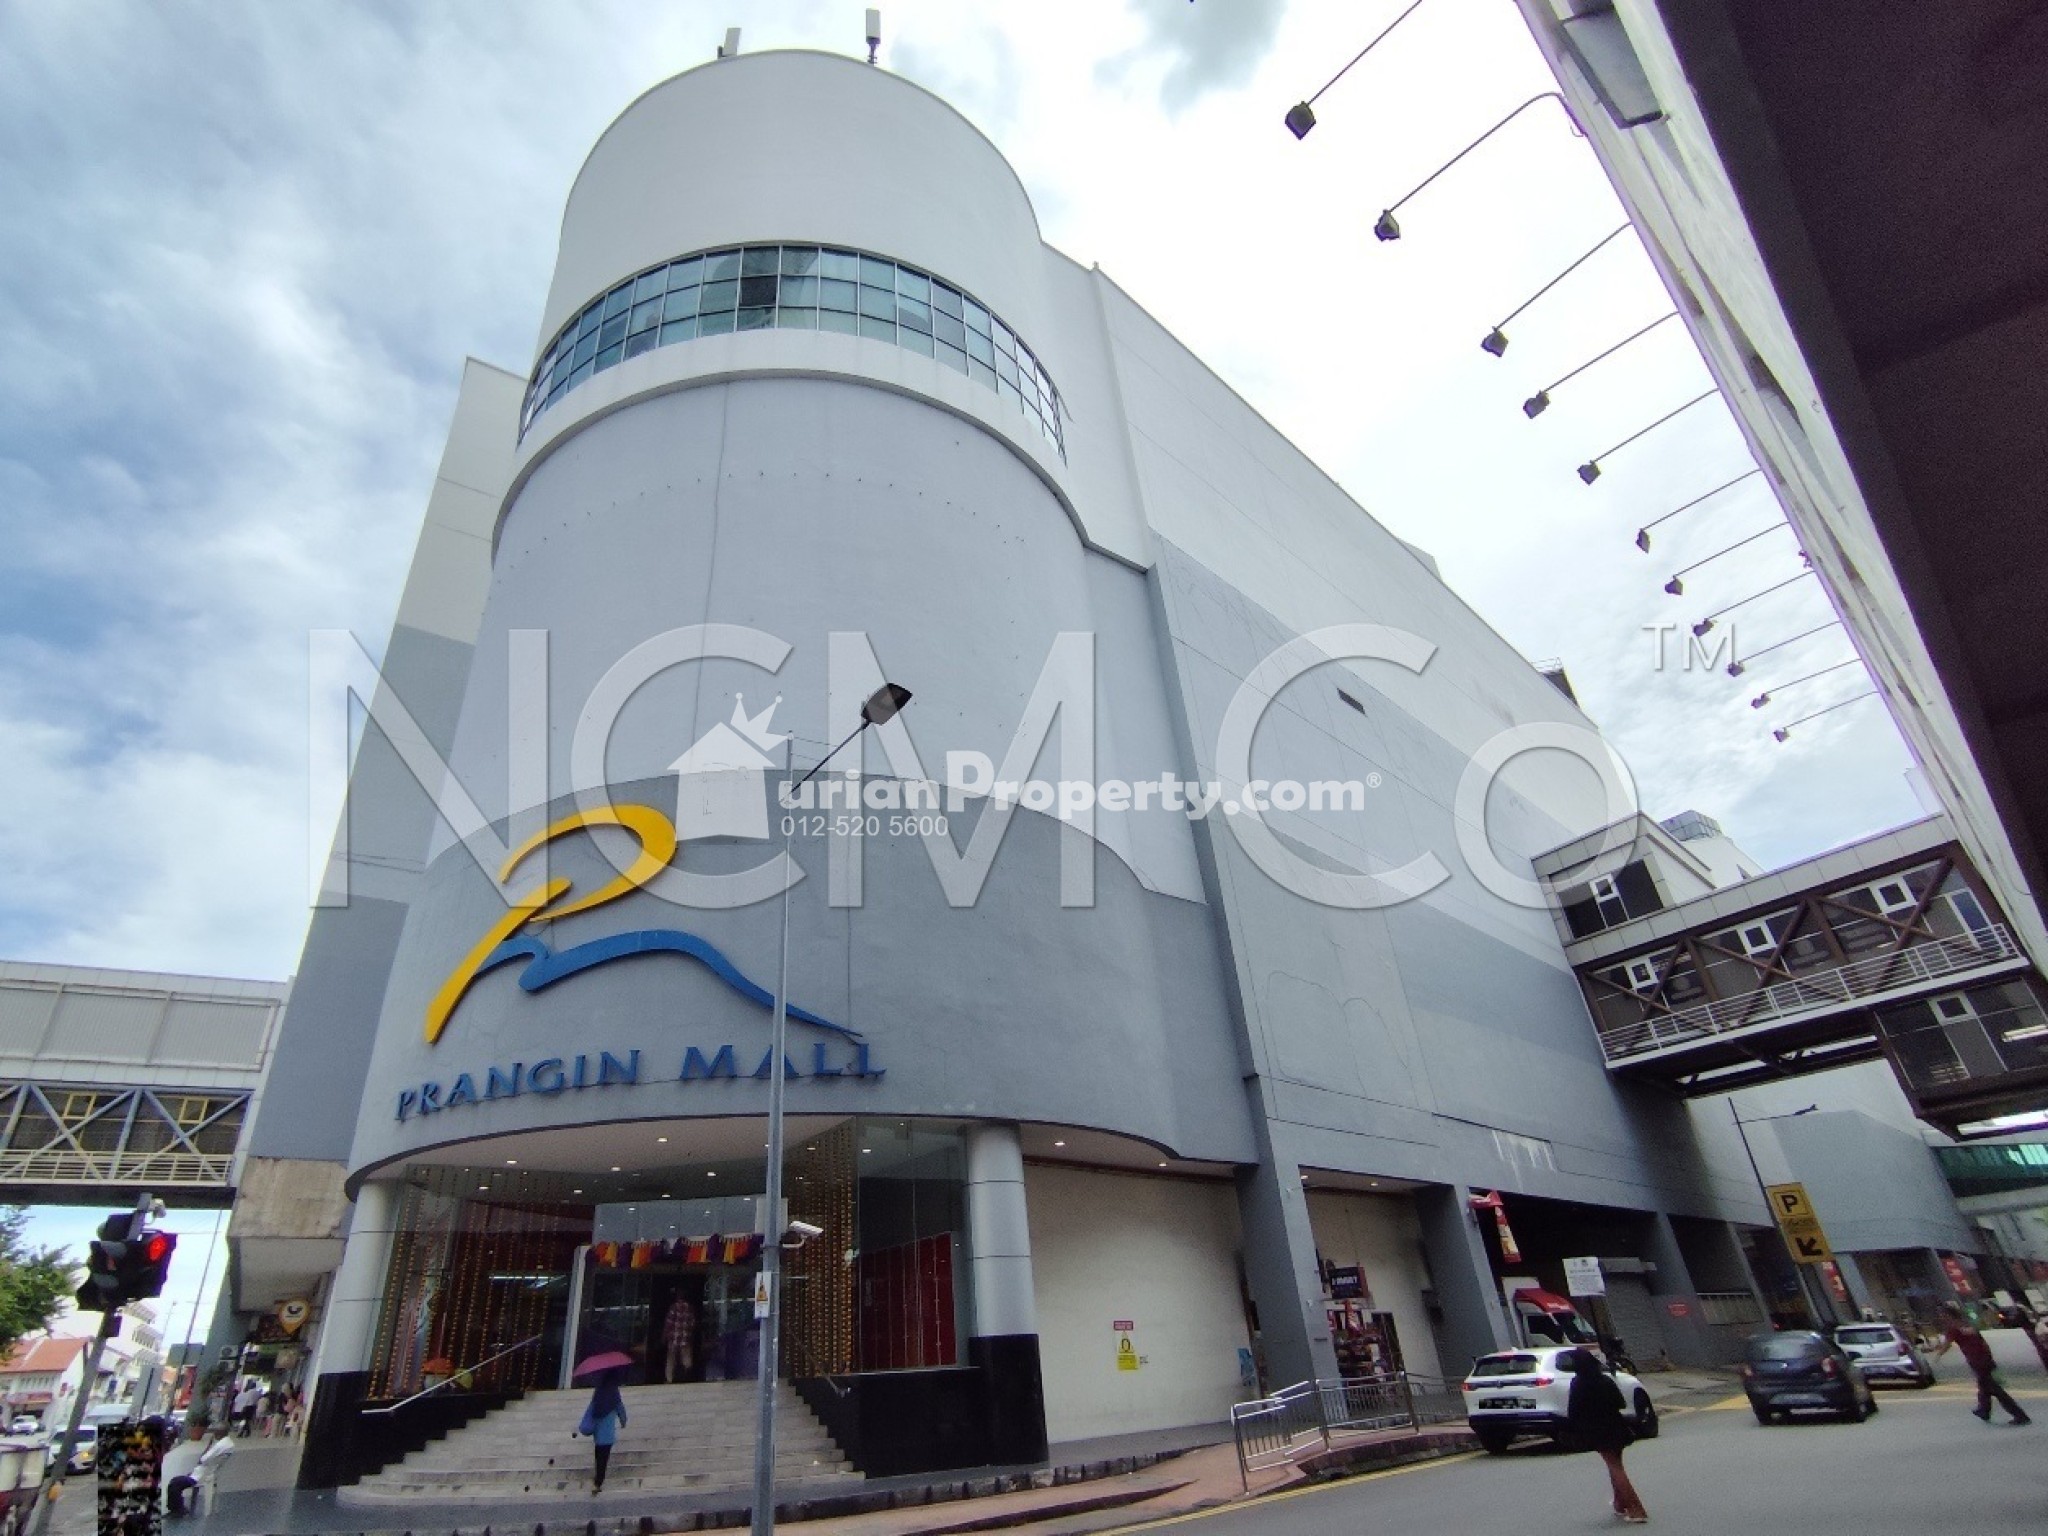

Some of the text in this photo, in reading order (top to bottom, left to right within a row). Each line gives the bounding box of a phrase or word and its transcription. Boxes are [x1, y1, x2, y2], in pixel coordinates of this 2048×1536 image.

[394, 1042, 886, 1121] PRANGIN MALL
[1781, 1194, 1799, 1214] P
